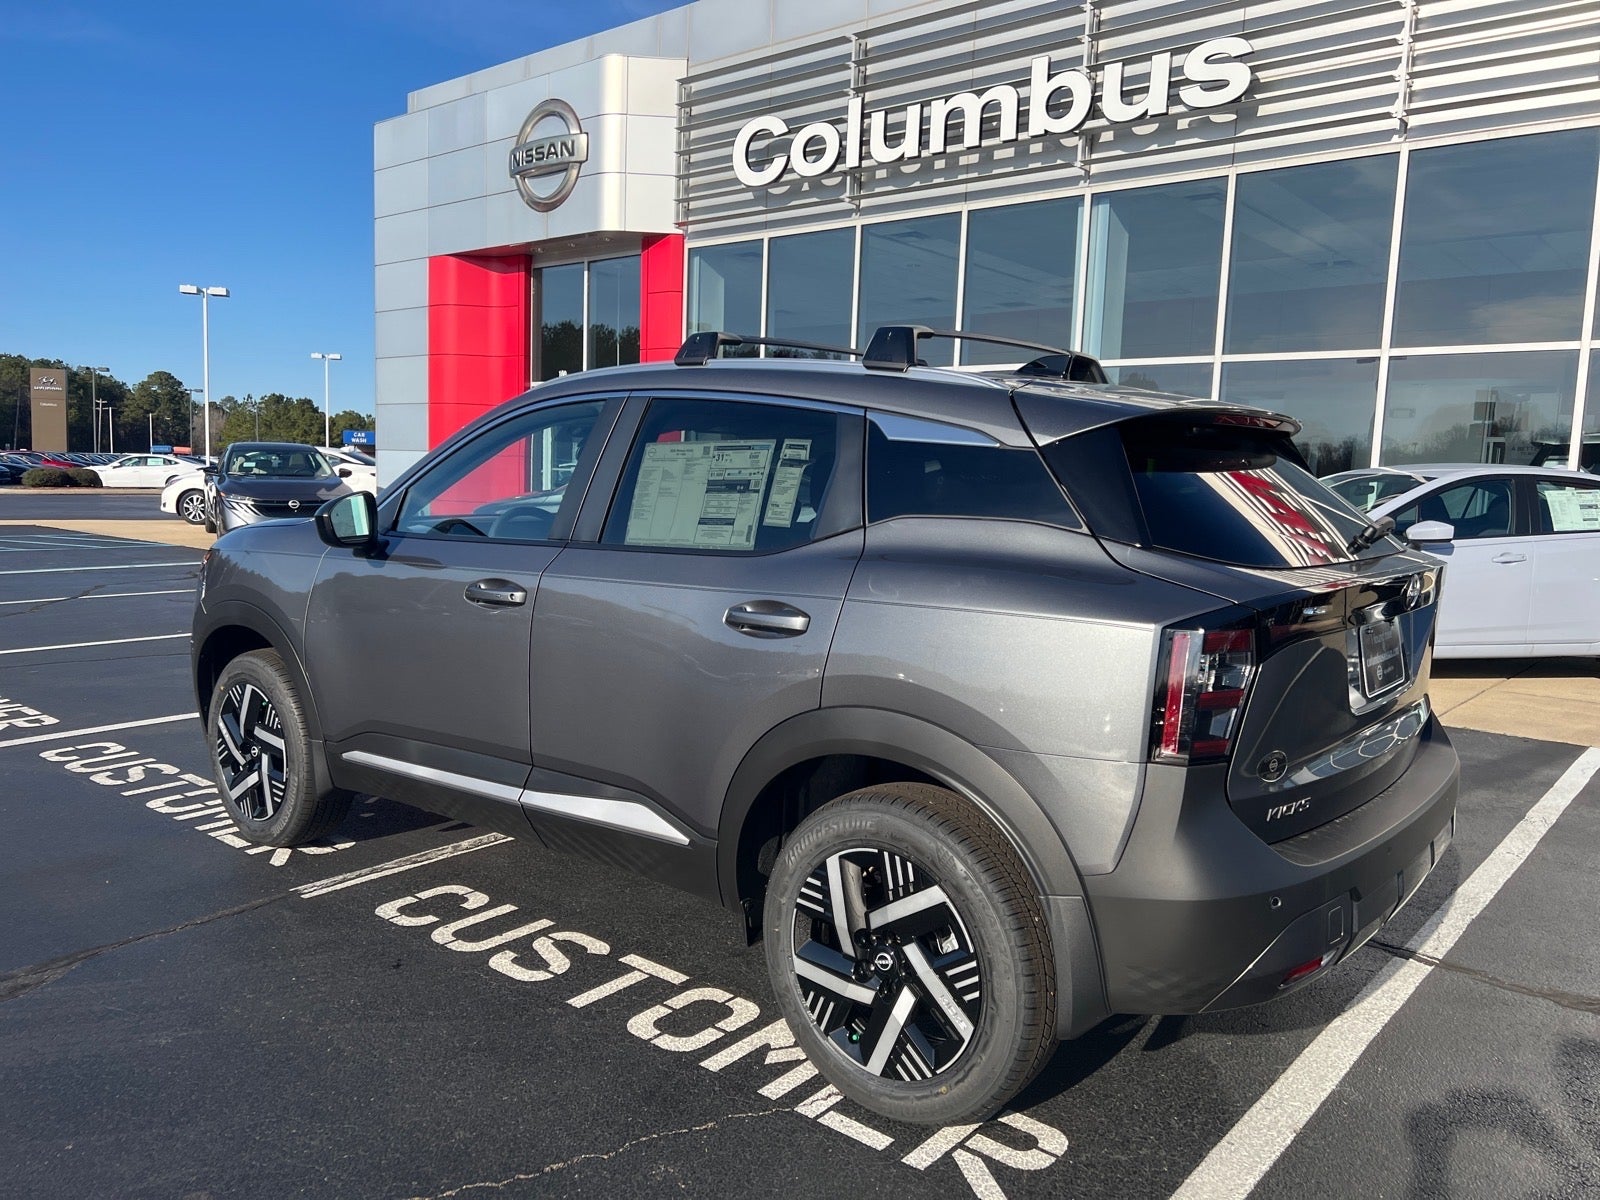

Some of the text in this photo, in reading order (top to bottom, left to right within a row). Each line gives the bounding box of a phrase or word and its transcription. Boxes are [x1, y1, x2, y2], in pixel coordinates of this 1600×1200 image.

[732, 36, 1255, 188] Columbus
[511, 140, 575, 169] NISSAN
[1266, 796, 1312, 822] KICKS
